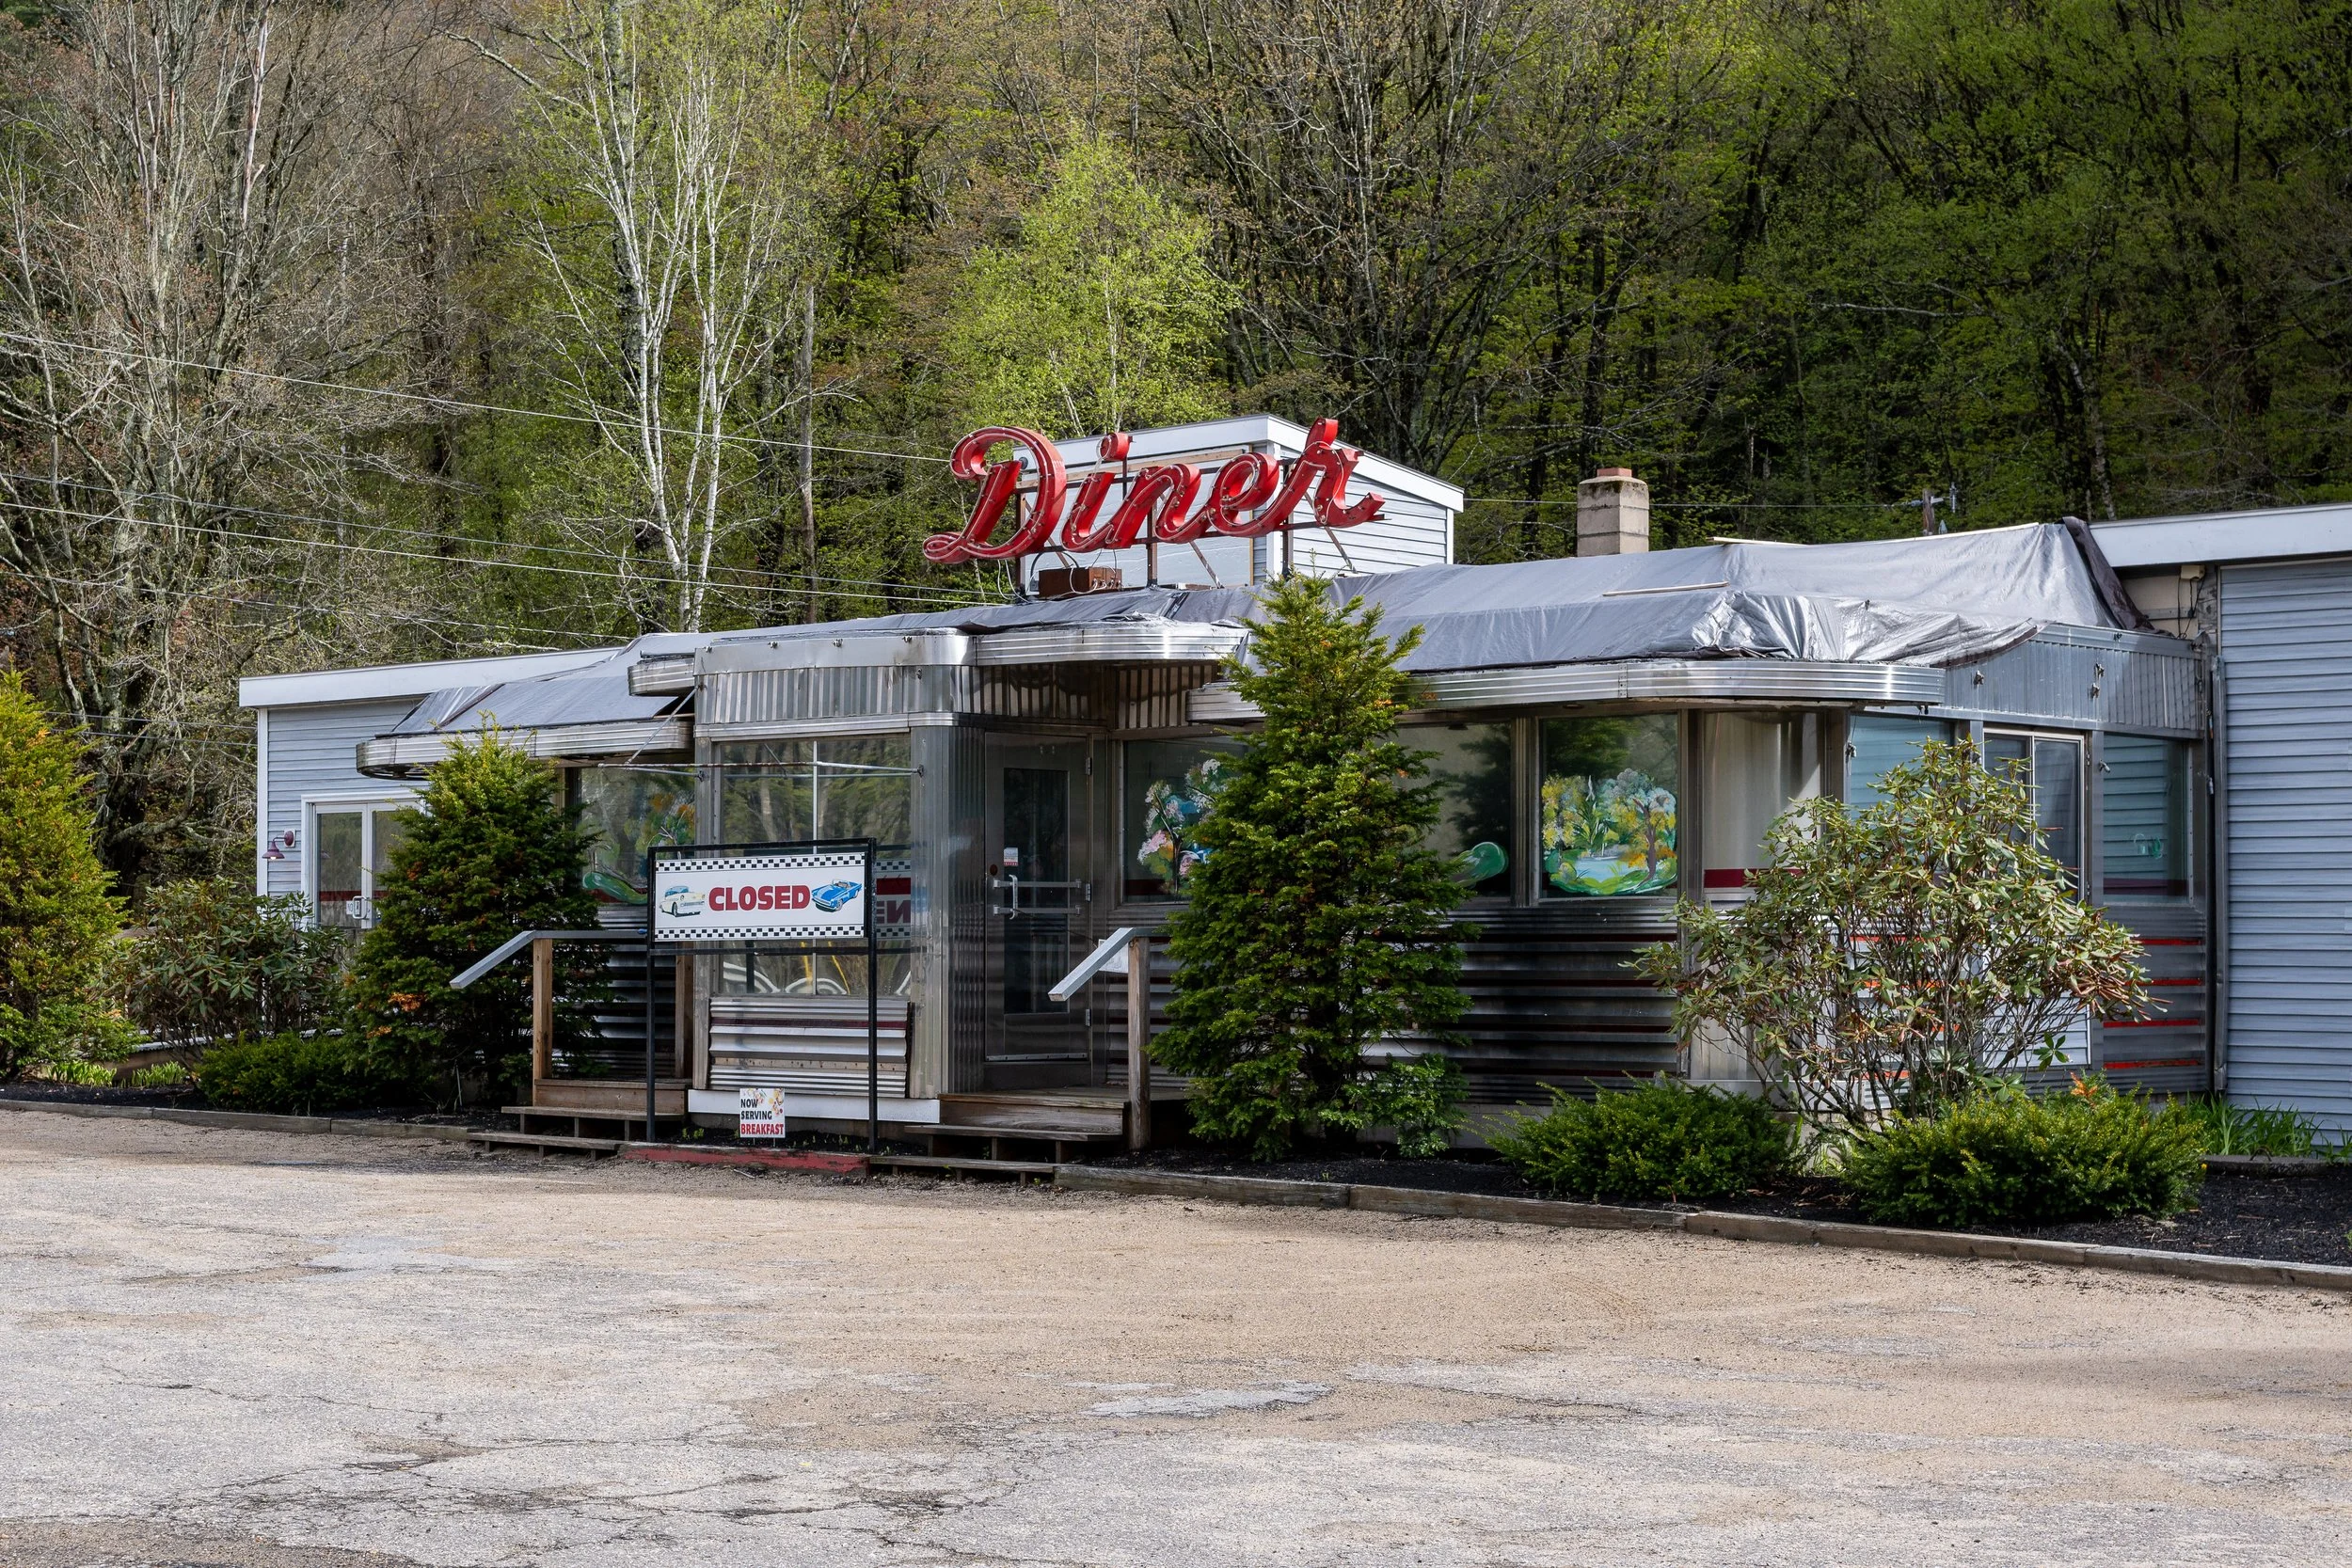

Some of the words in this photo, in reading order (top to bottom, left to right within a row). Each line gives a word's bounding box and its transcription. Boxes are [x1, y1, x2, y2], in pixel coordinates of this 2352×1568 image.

[923, 418, 1385, 563] Diner
[708, 885, 811, 911] CLOSED
[740, 1099, 758, 1108] NOW
[740, 1110, 772, 1119] SERVING
[740, 1123, 784, 1134] BREAKFAST
